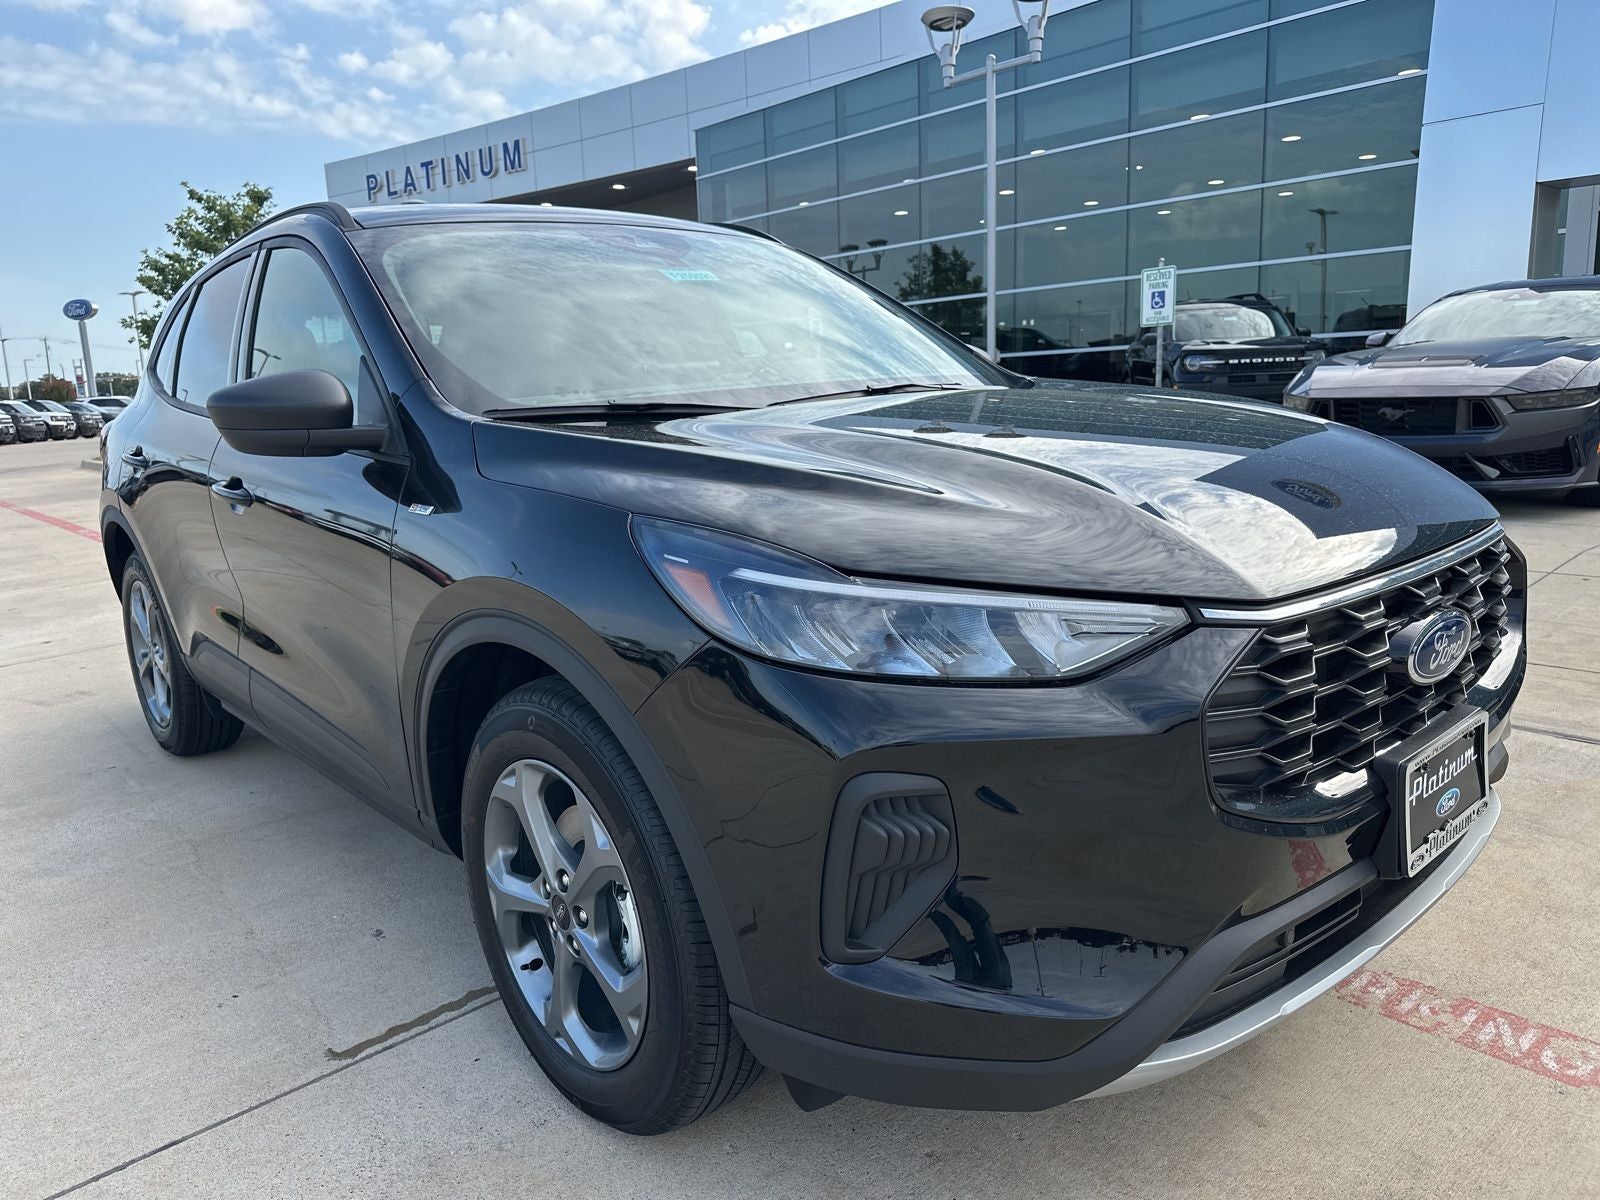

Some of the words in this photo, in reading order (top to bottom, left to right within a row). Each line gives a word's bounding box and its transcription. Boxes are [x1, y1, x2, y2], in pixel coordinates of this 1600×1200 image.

[366, 139, 524, 201] PLATINUM
[1146, 270, 1171, 282] RESERVED
[1149, 281, 1168, 290] PARKING
[68, 303, 86, 317] Ford
[1228, 356, 1296, 365] BRONCO
[1429, 625, 1465, 670] Ford
[1409, 745, 1478, 807] Platinum
[1440, 793, 1456, 814] Ford
